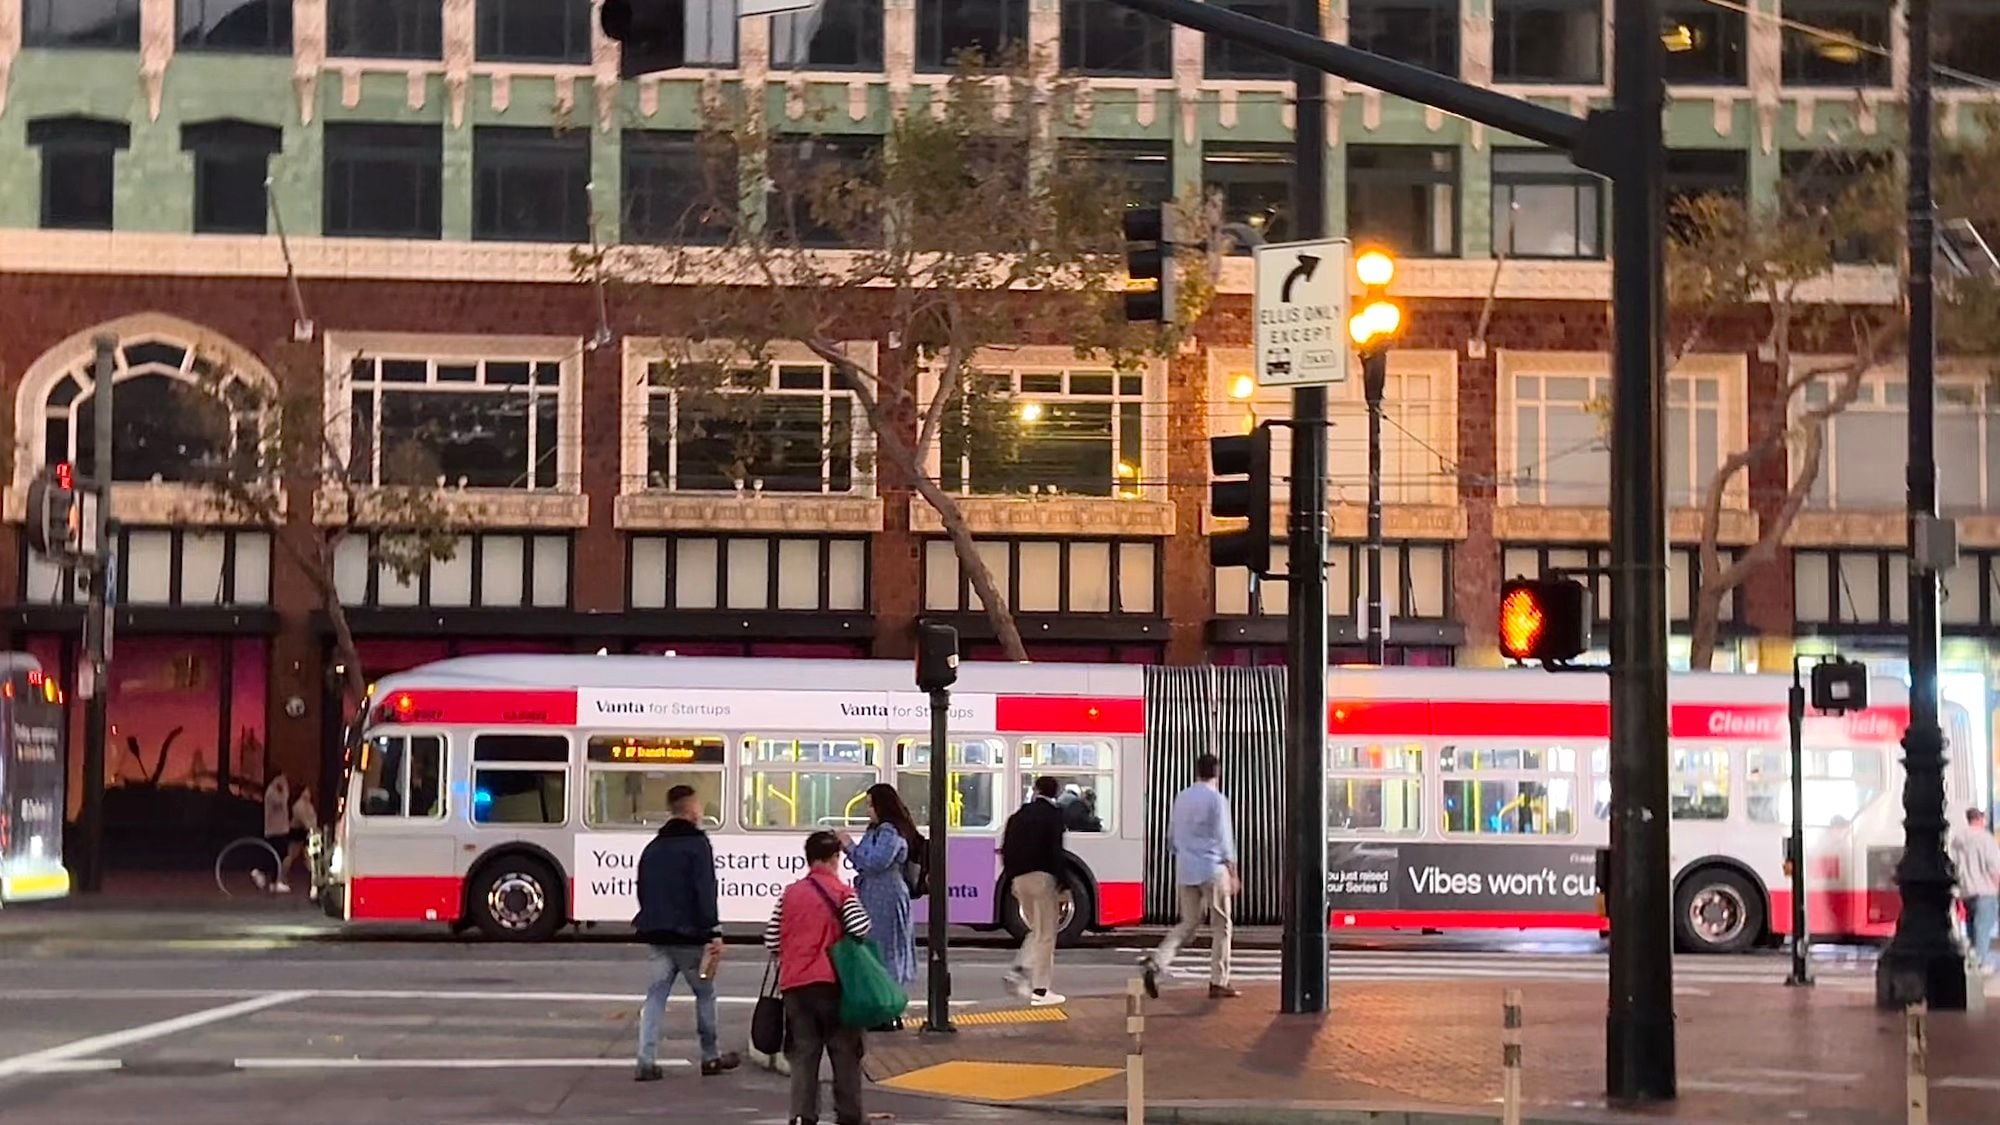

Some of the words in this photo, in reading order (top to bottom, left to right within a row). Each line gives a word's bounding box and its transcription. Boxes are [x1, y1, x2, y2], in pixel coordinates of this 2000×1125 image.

[1261, 307, 1299, 325] ELLIS
[1303, 304, 1340, 321] ONLY
[1271, 325, 1332, 344] EXCEPT
[596, 700, 645, 714] Vanta
[649, 702, 669, 715] for
[671, 702, 731, 716] Startups
[840, 703, 888, 717] Vanta
[892, 705, 912, 718] for
[915, 706, 974, 719] Stups
[1708, 710, 1768, 733] Clean
[592, 850, 634, 869] You
[714, 853, 770, 870] start
[1340, 870, 1358, 883] just
[1408, 866, 1482, 894] Vibes
[1488, 867, 1557, 896] won't
[1562, 873, 1600, 897] cu
[948, 885, 979, 898] nta
[1327, 883, 1344, 893] our
[1345, 881, 1377, 894] Series
